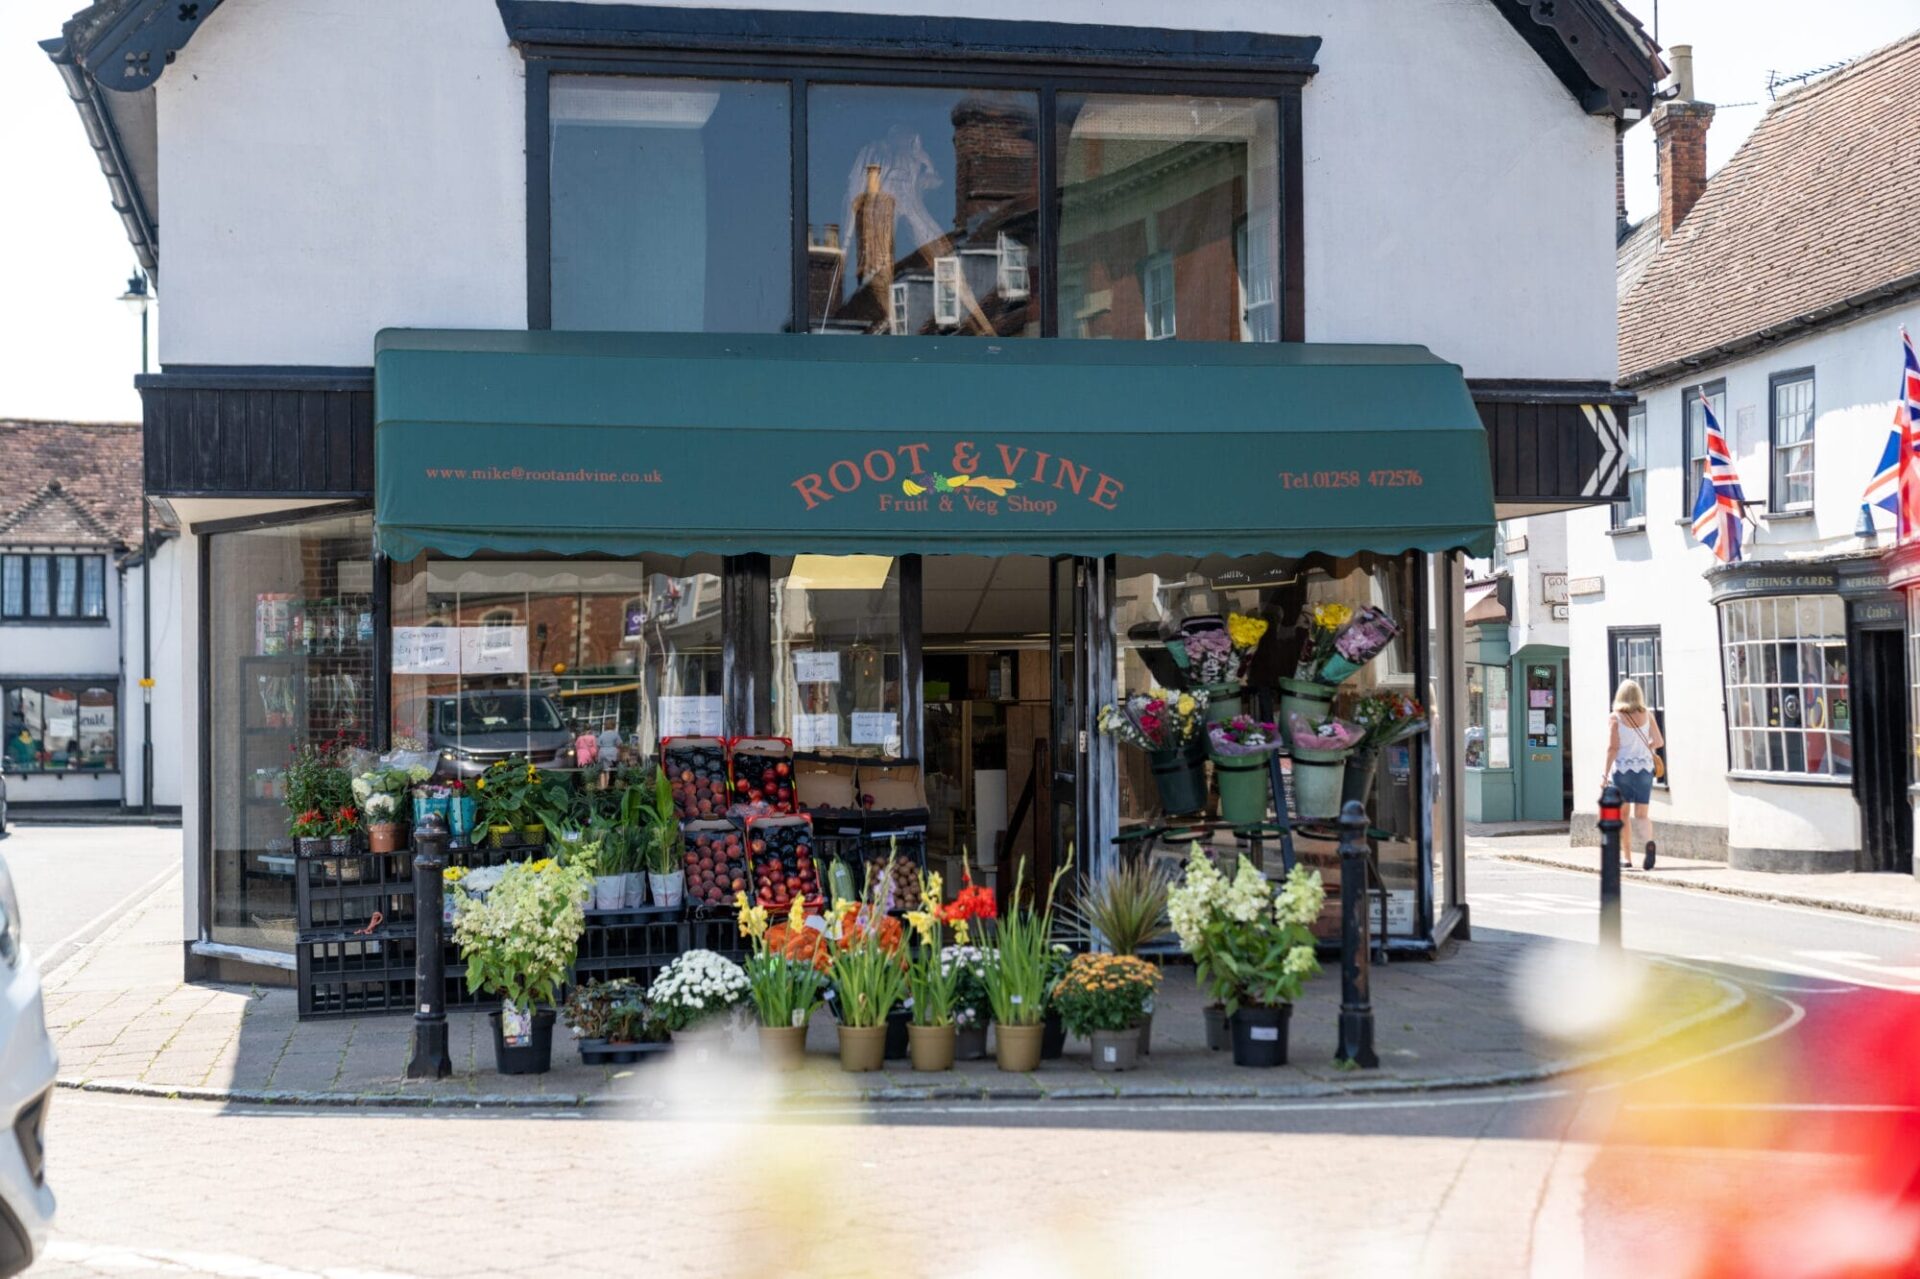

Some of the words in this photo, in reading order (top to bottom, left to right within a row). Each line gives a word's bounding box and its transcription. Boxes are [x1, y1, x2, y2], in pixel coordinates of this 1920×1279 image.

[791, 443, 929, 511] ROOT
[952, 441, 980, 474] &
[995, 443, 1125, 511] VINE
[1368, 470, 1423, 486] 472576
[880, 494, 929, 513] Fruit
[938, 495, 954, 513] &
[965, 494, 999, 516] Veg
[1008, 494, 1058, 516] Shop
[1796, 575, 1834, 587] CARDS
